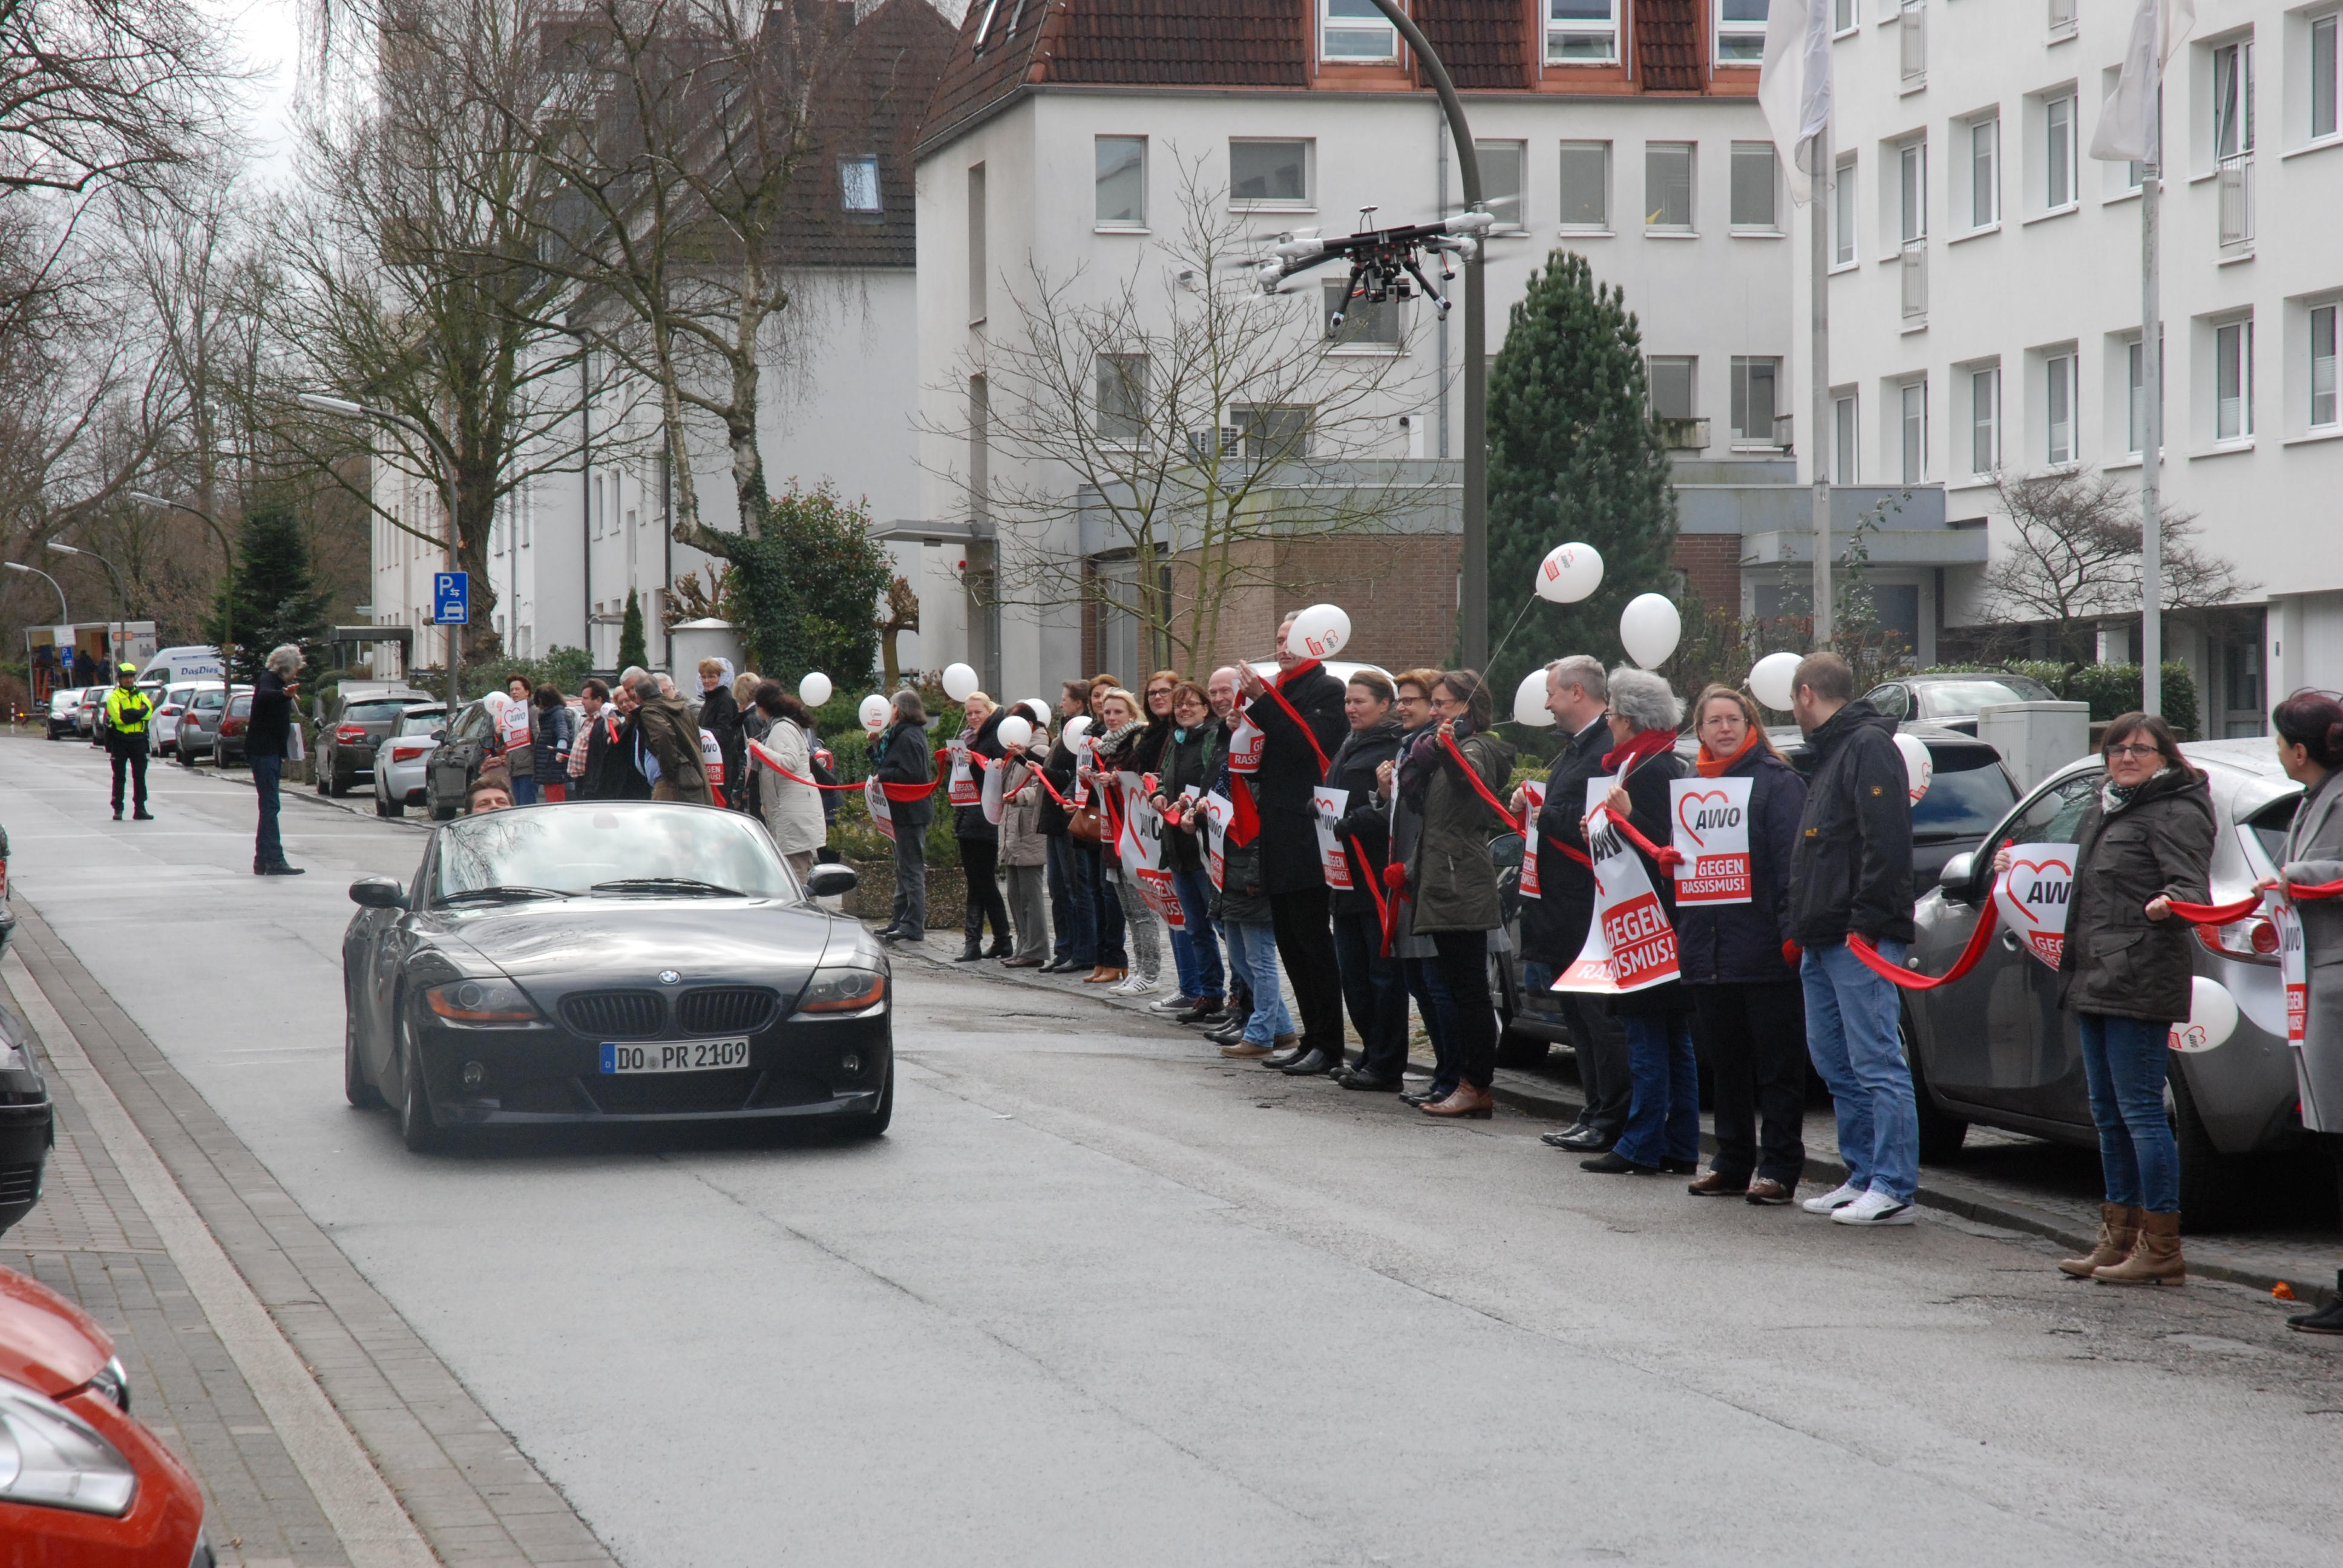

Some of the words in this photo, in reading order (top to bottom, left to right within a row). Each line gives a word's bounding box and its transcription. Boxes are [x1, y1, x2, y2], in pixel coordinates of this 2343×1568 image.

[510, 712, 526, 722] AWO
[703, 743, 717, 753] WO
[956, 783, 975, 791] GEGEN
[873, 794, 886, 806] AWO
[1695, 807, 1740, 830] AWO
[1591, 823, 1622, 866] AW
[1328, 855, 1345, 868] EGEN
[1523, 855, 1535, 872] EGEN
[1699, 859, 1744, 876] GEGEN
[1682, 878, 1745, 893] RASSISMUS!
[2027, 881, 2072, 903] AW
[1606, 902, 1668, 949] GEGEN
[2035, 936, 2064, 953] GEG
[2286, 926, 2301, 951] WO
[617, 1047, 644, 1070] DO
[663, 1046, 689, 1068] PR
[695, 1042, 746, 1067] 2109
